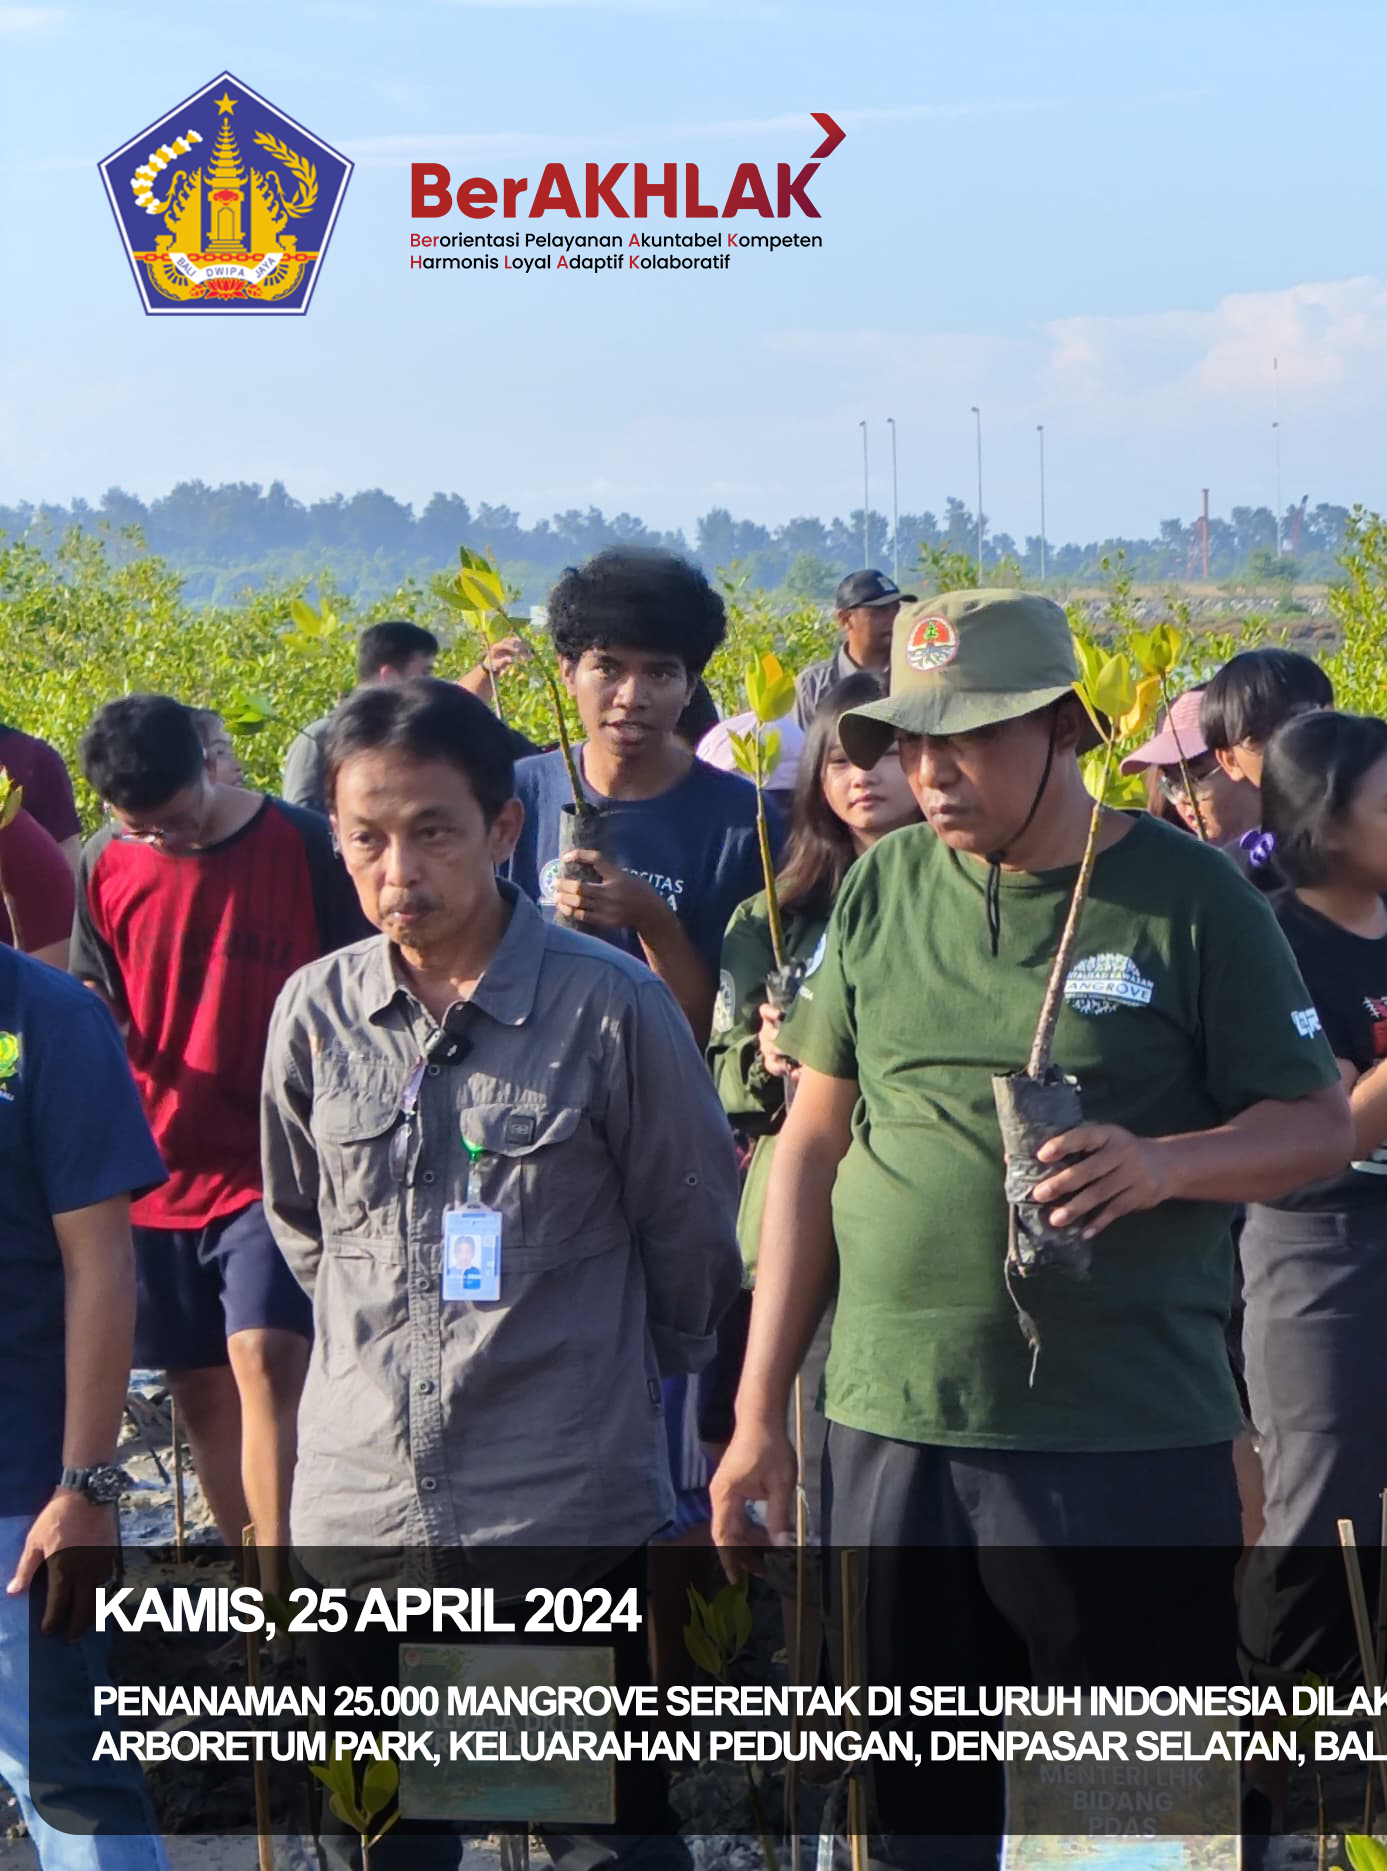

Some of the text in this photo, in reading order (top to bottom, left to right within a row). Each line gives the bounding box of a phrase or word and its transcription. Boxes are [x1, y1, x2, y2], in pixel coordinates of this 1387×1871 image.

[1067, 980, 1150, 1000] ANGROVE
[1039, 1764, 1204, 1788] MENTERI LHK
[1072, 1790, 1174, 1812] BIDANG
[1088, 1816, 1158, 1839] PDAS
